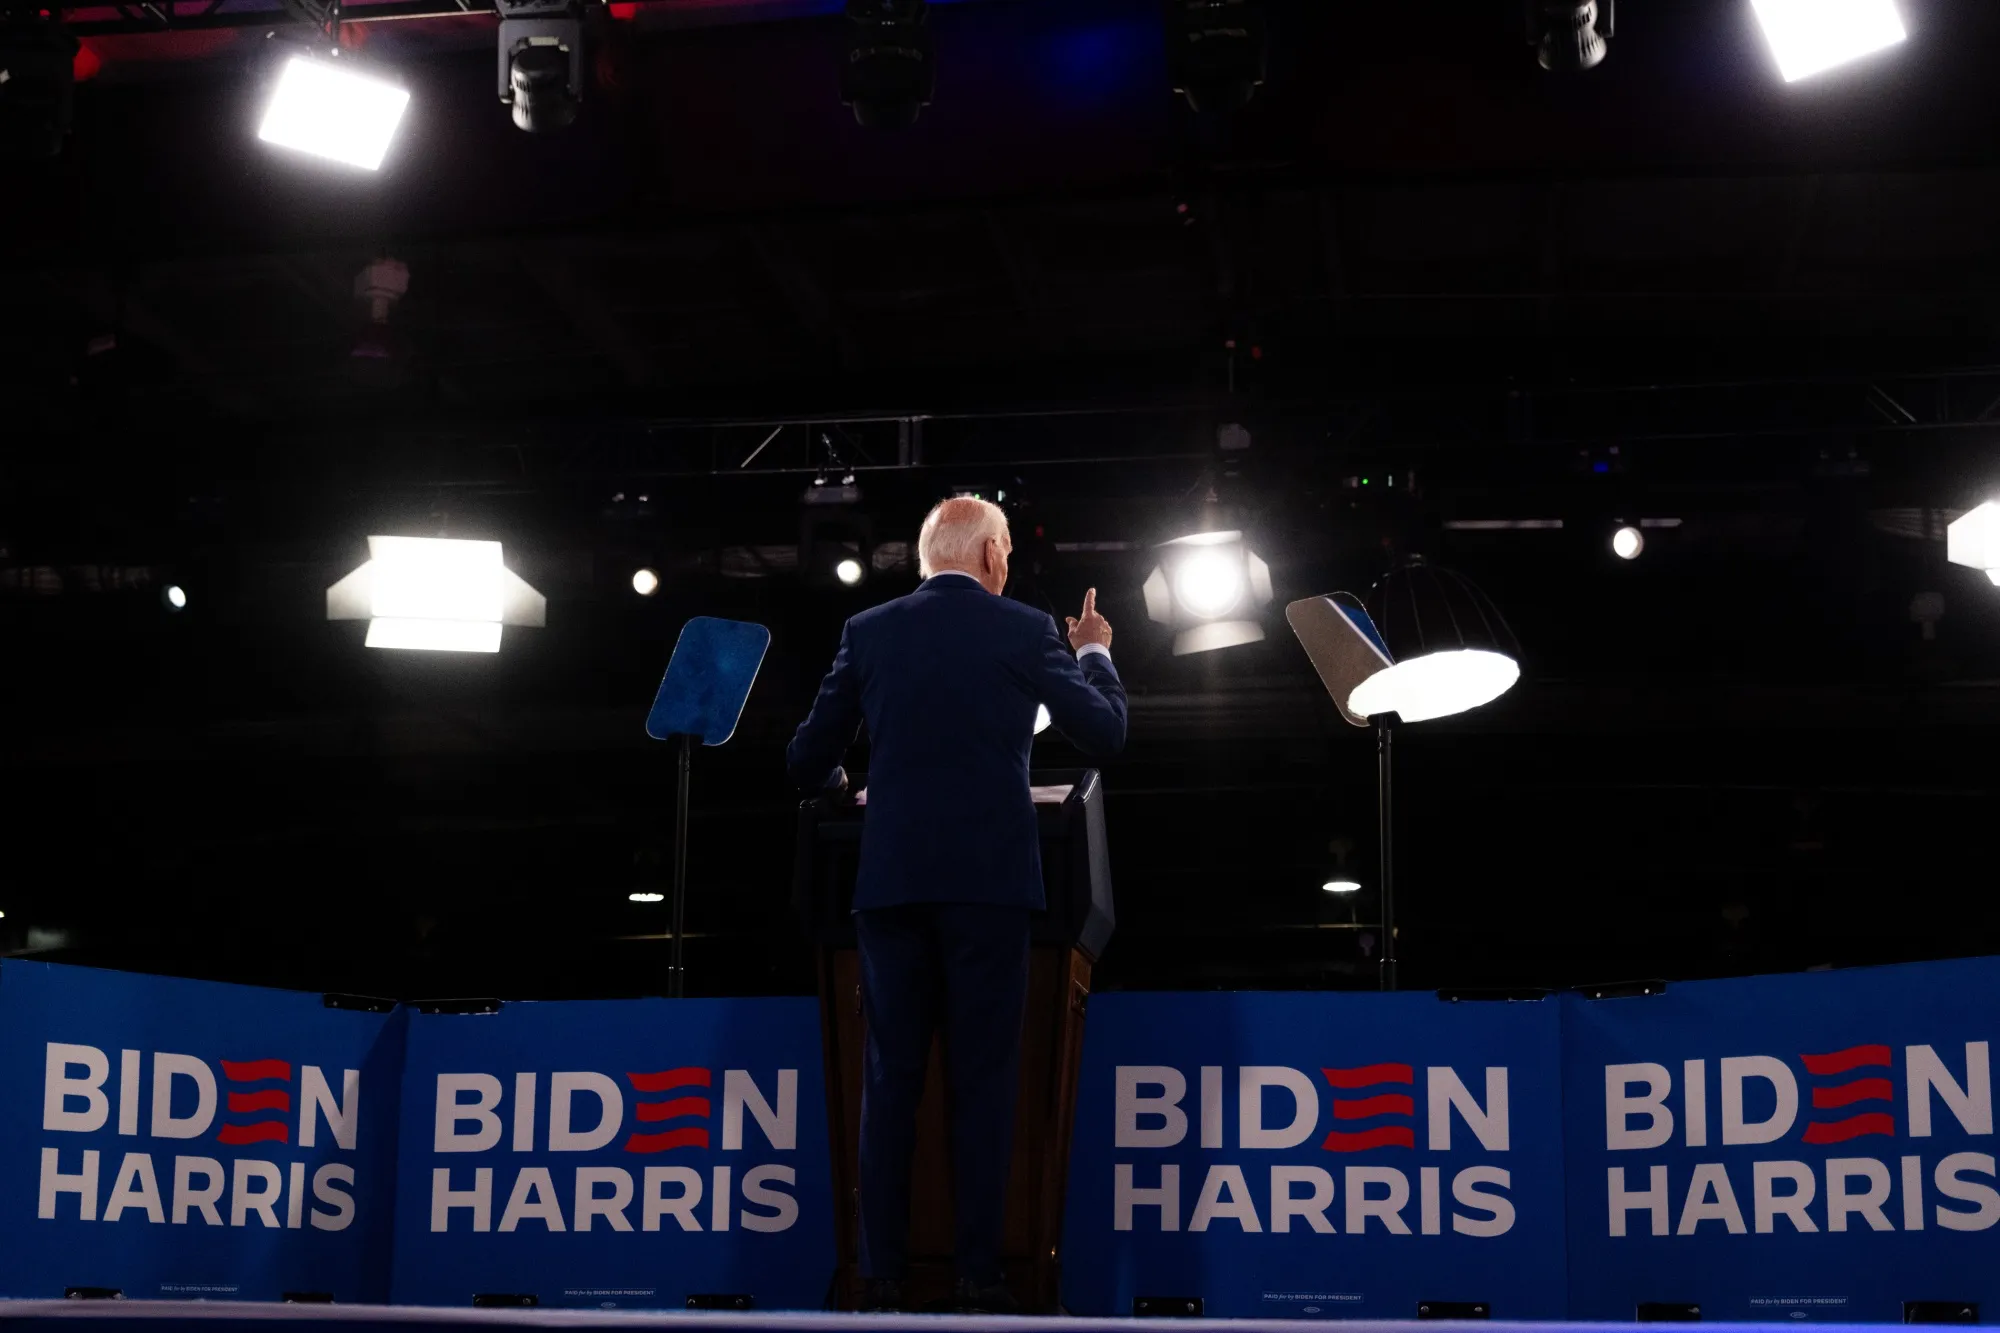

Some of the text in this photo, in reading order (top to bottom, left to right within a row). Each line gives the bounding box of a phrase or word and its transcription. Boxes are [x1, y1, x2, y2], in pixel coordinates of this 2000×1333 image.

[43, 1042, 359, 1150] BIDEN
[434, 1067, 798, 1153] BIDEN
[1115, 1063, 1510, 1152] BIDEN
[1604, 1041, 1993, 1150] BIDEN
[38, 1147, 355, 1231] HARRIS
[430, 1164, 799, 1233] HARRIS
[1114, 1164, 1516, 1237] HARRIS
[1607, 1152, 2000, 1237] HARRIS
